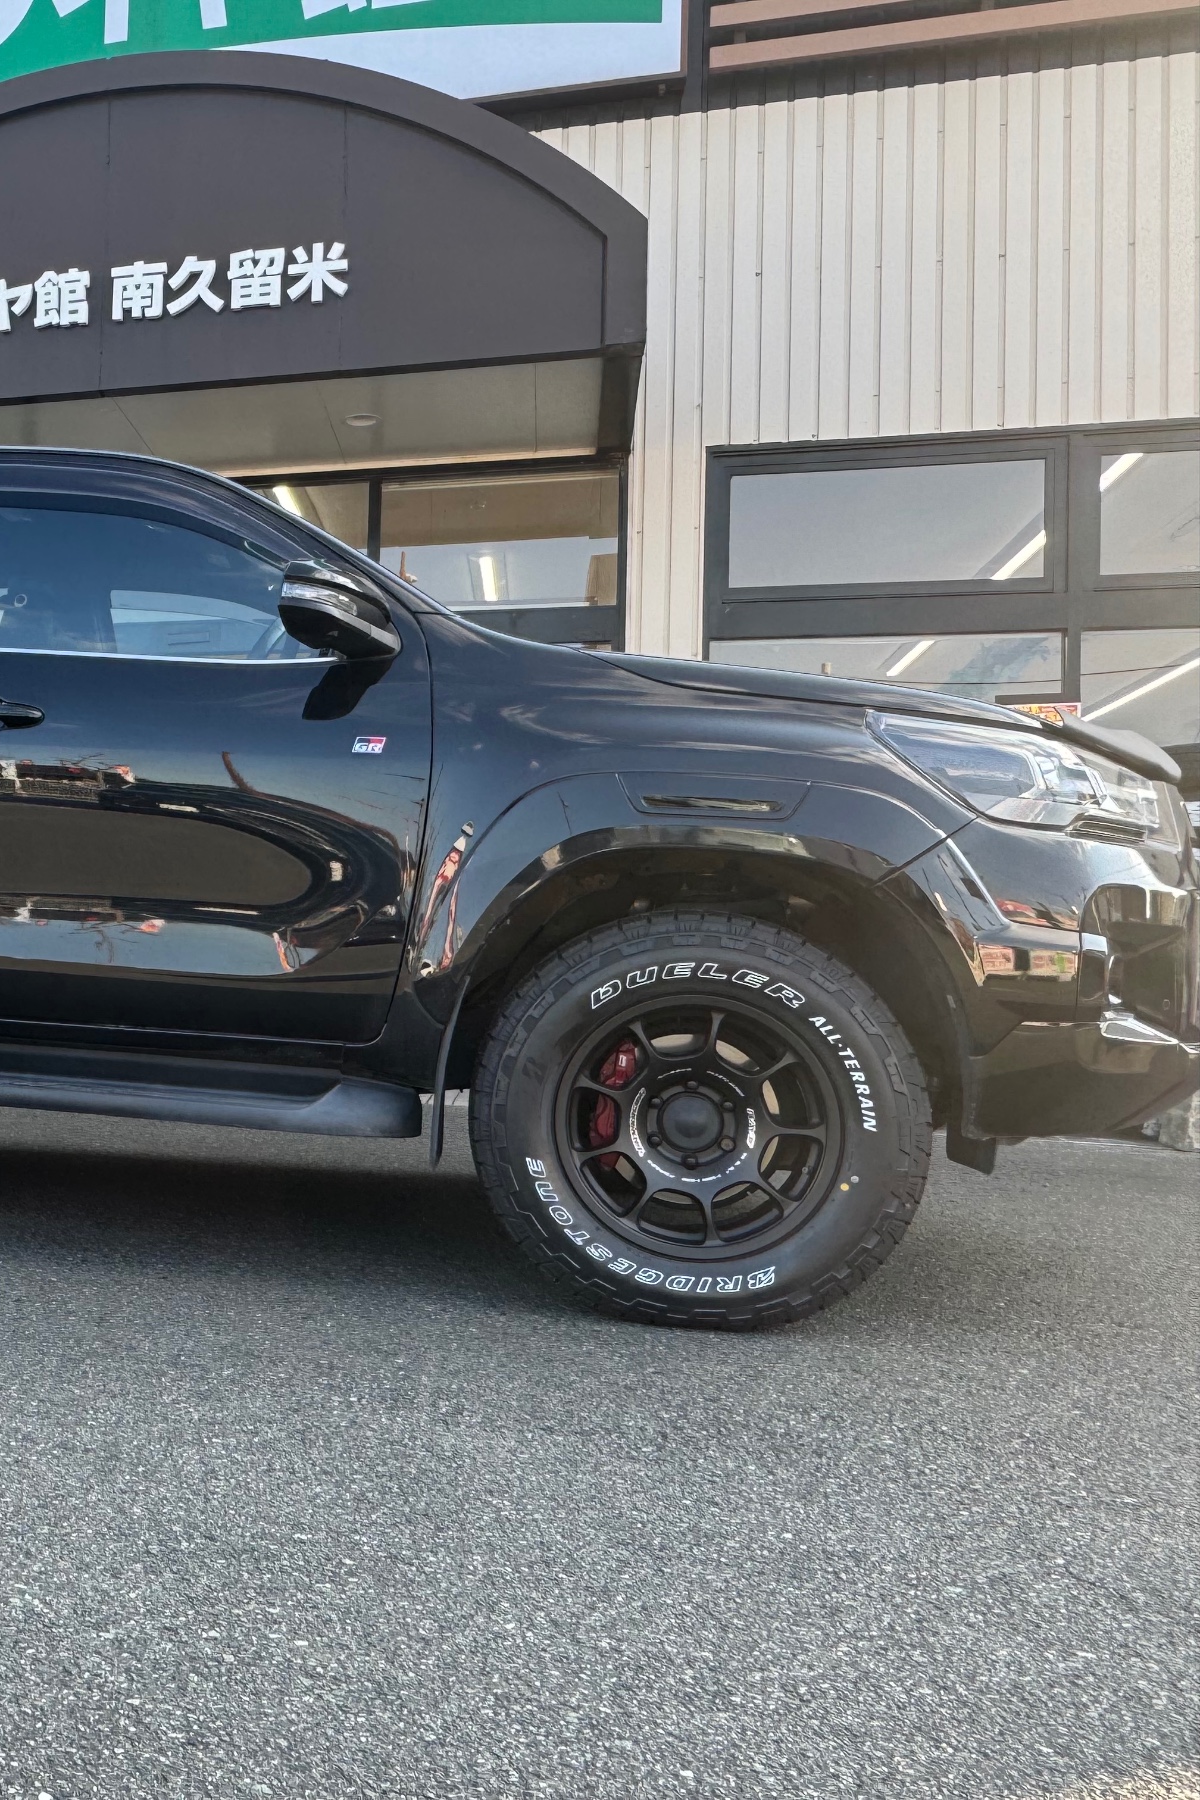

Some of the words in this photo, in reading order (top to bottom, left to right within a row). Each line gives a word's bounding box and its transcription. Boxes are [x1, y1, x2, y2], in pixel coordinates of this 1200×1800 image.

[111, 242, 349, 321] 南久留米
[354, 741, 383, 753] GR
[590, 962, 806, 1010] DUELER
[525, 1157, 776, 1293] BRIDGESTONE
